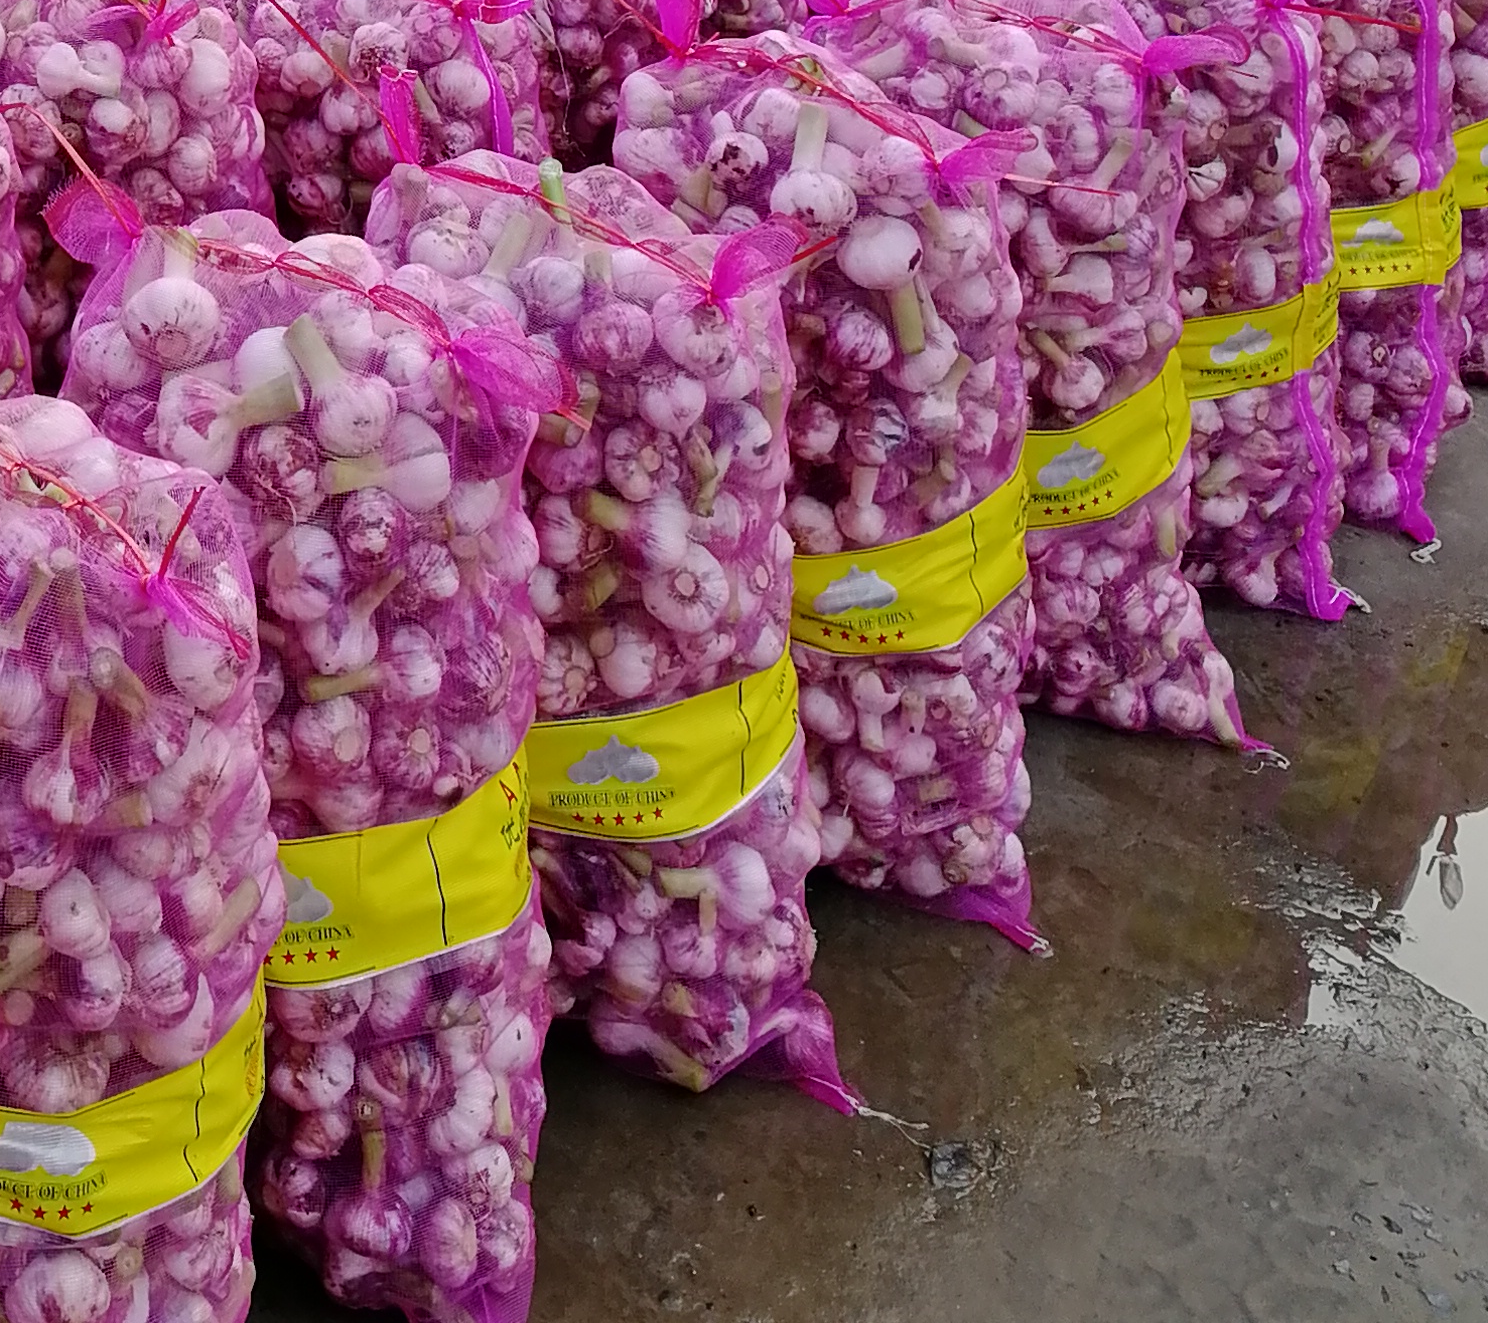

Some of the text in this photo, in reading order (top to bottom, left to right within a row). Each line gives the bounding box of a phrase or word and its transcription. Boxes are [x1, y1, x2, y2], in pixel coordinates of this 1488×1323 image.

[876, 610, 916, 627] CHINA
[548, 787, 675, 808] PRODUCT OF CHINA
[284, 930, 303, 944] OF
[306, 925, 353, 943] CHINA
[37, 1183, 63, 1200] OF
[64, 1171, 107, 1200] CHINA
